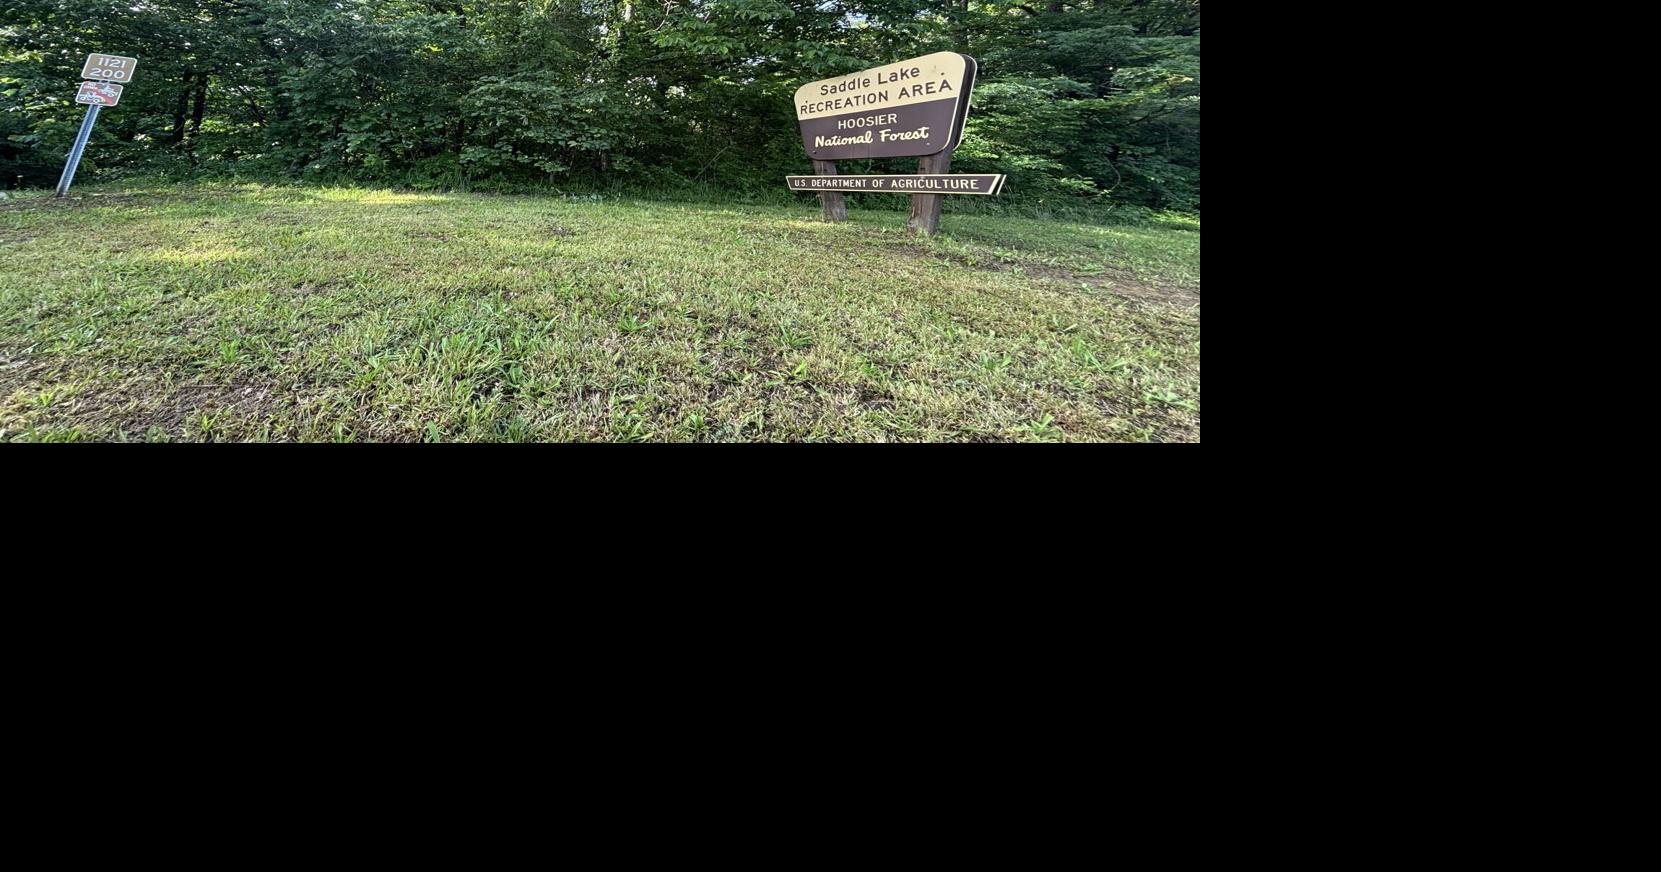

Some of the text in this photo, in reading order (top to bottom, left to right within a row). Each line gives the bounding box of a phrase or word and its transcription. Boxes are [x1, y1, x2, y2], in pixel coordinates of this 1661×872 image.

[98, 58, 126, 69] 1121
[90, 67, 125, 78] 200
[820, 66, 920, 96] Saddle Lake
[800, 79, 953, 115] RECREATION AREA
[838, 113, 898, 130] HOOSIER
[814, 126, 930, 148] National Forest
[811, 179, 866, 188] DEPARTMENT
[872, 179, 884, 188] OF
[891, 179, 980, 190] AGRICULTURE
